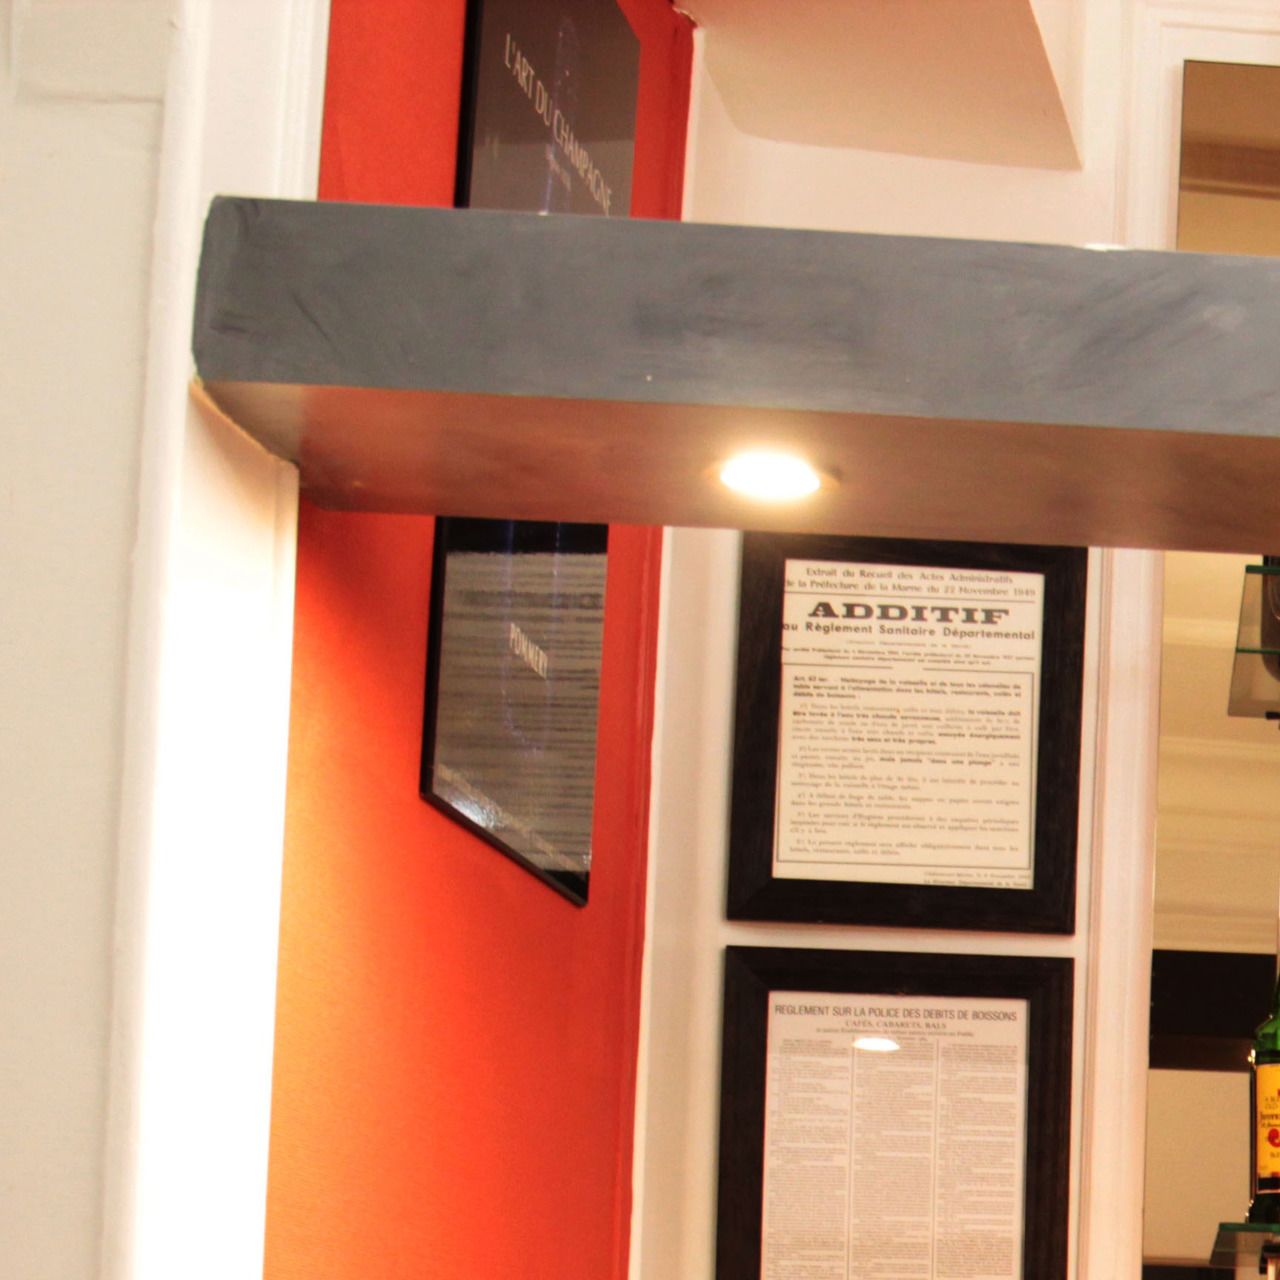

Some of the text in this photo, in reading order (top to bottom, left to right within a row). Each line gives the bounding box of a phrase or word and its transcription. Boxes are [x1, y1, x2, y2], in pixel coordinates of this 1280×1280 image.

[504, 33, 535, 99] L'ART
[536, 80, 553, 126] DU
[842, 569, 855, 578] du
[786, 579, 794, 587] e
[808, 602, 1009, 625] ADDITIF
[804, 622, 872, 634] Règlement
[878, 625, 935, 636] Sanitaire
[942, 628, 1035, 640] Départemental
[832, 1005, 852, 1017] SUR
[853, 1007, 866, 1018] LA
[868, 1007, 900, 1018] POLICE
[902, 1008, 920, 1019] DES
[957, 1009, 968, 1020] DE
[971, 1010, 1017, 1022] BOISSONS
